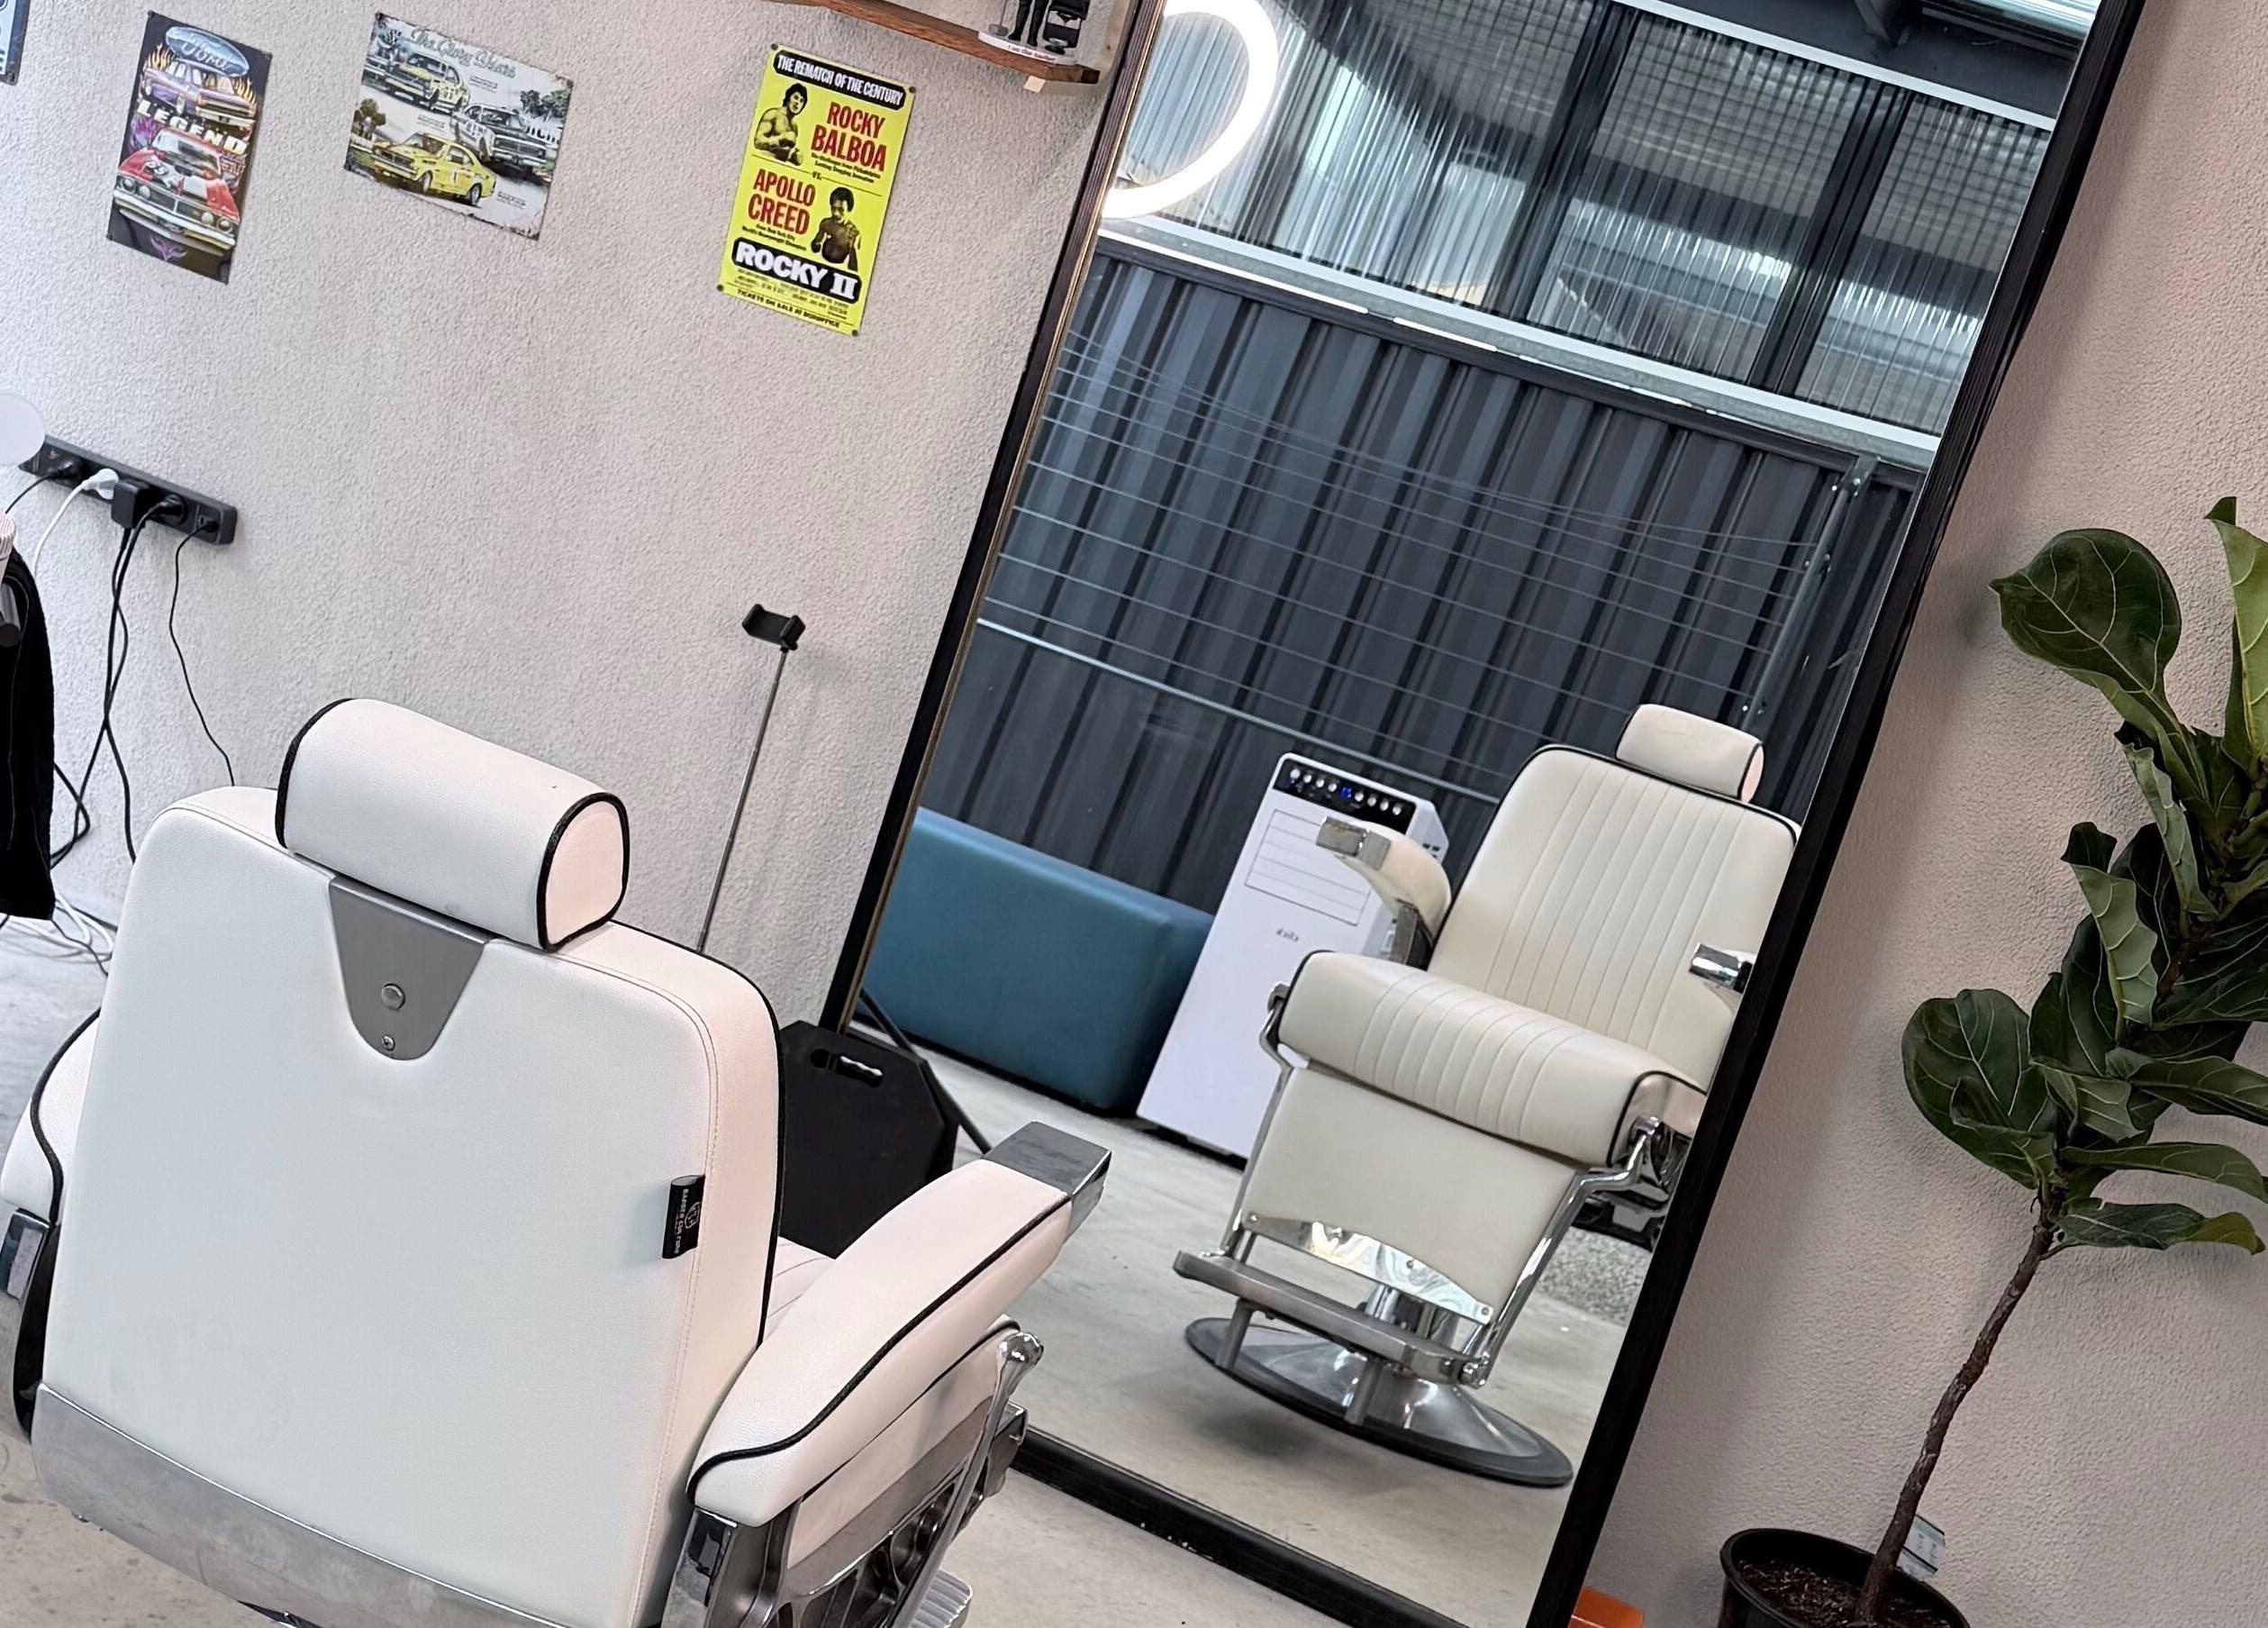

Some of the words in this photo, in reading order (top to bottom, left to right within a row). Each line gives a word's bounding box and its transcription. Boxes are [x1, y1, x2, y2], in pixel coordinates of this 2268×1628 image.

[776, 54, 793, 75] THE
[794, 58, 833, 86] REMATCH
[835, 71, 848, 90] OF
[847, 75, 864, 94] THE
[864, 78, 903, 105] CENTURY
[137, 100, 247, 155] LEGEND
[827, 102, 885, 139] ROCKY
[811, 124, 886, 171] BALBOA
[752, 168, 815, 206] APOLLO
[748, 194, 811, 235] CREED
[736, 241, 829, 289] ROCKY
[830, 271, 857, 300] II
